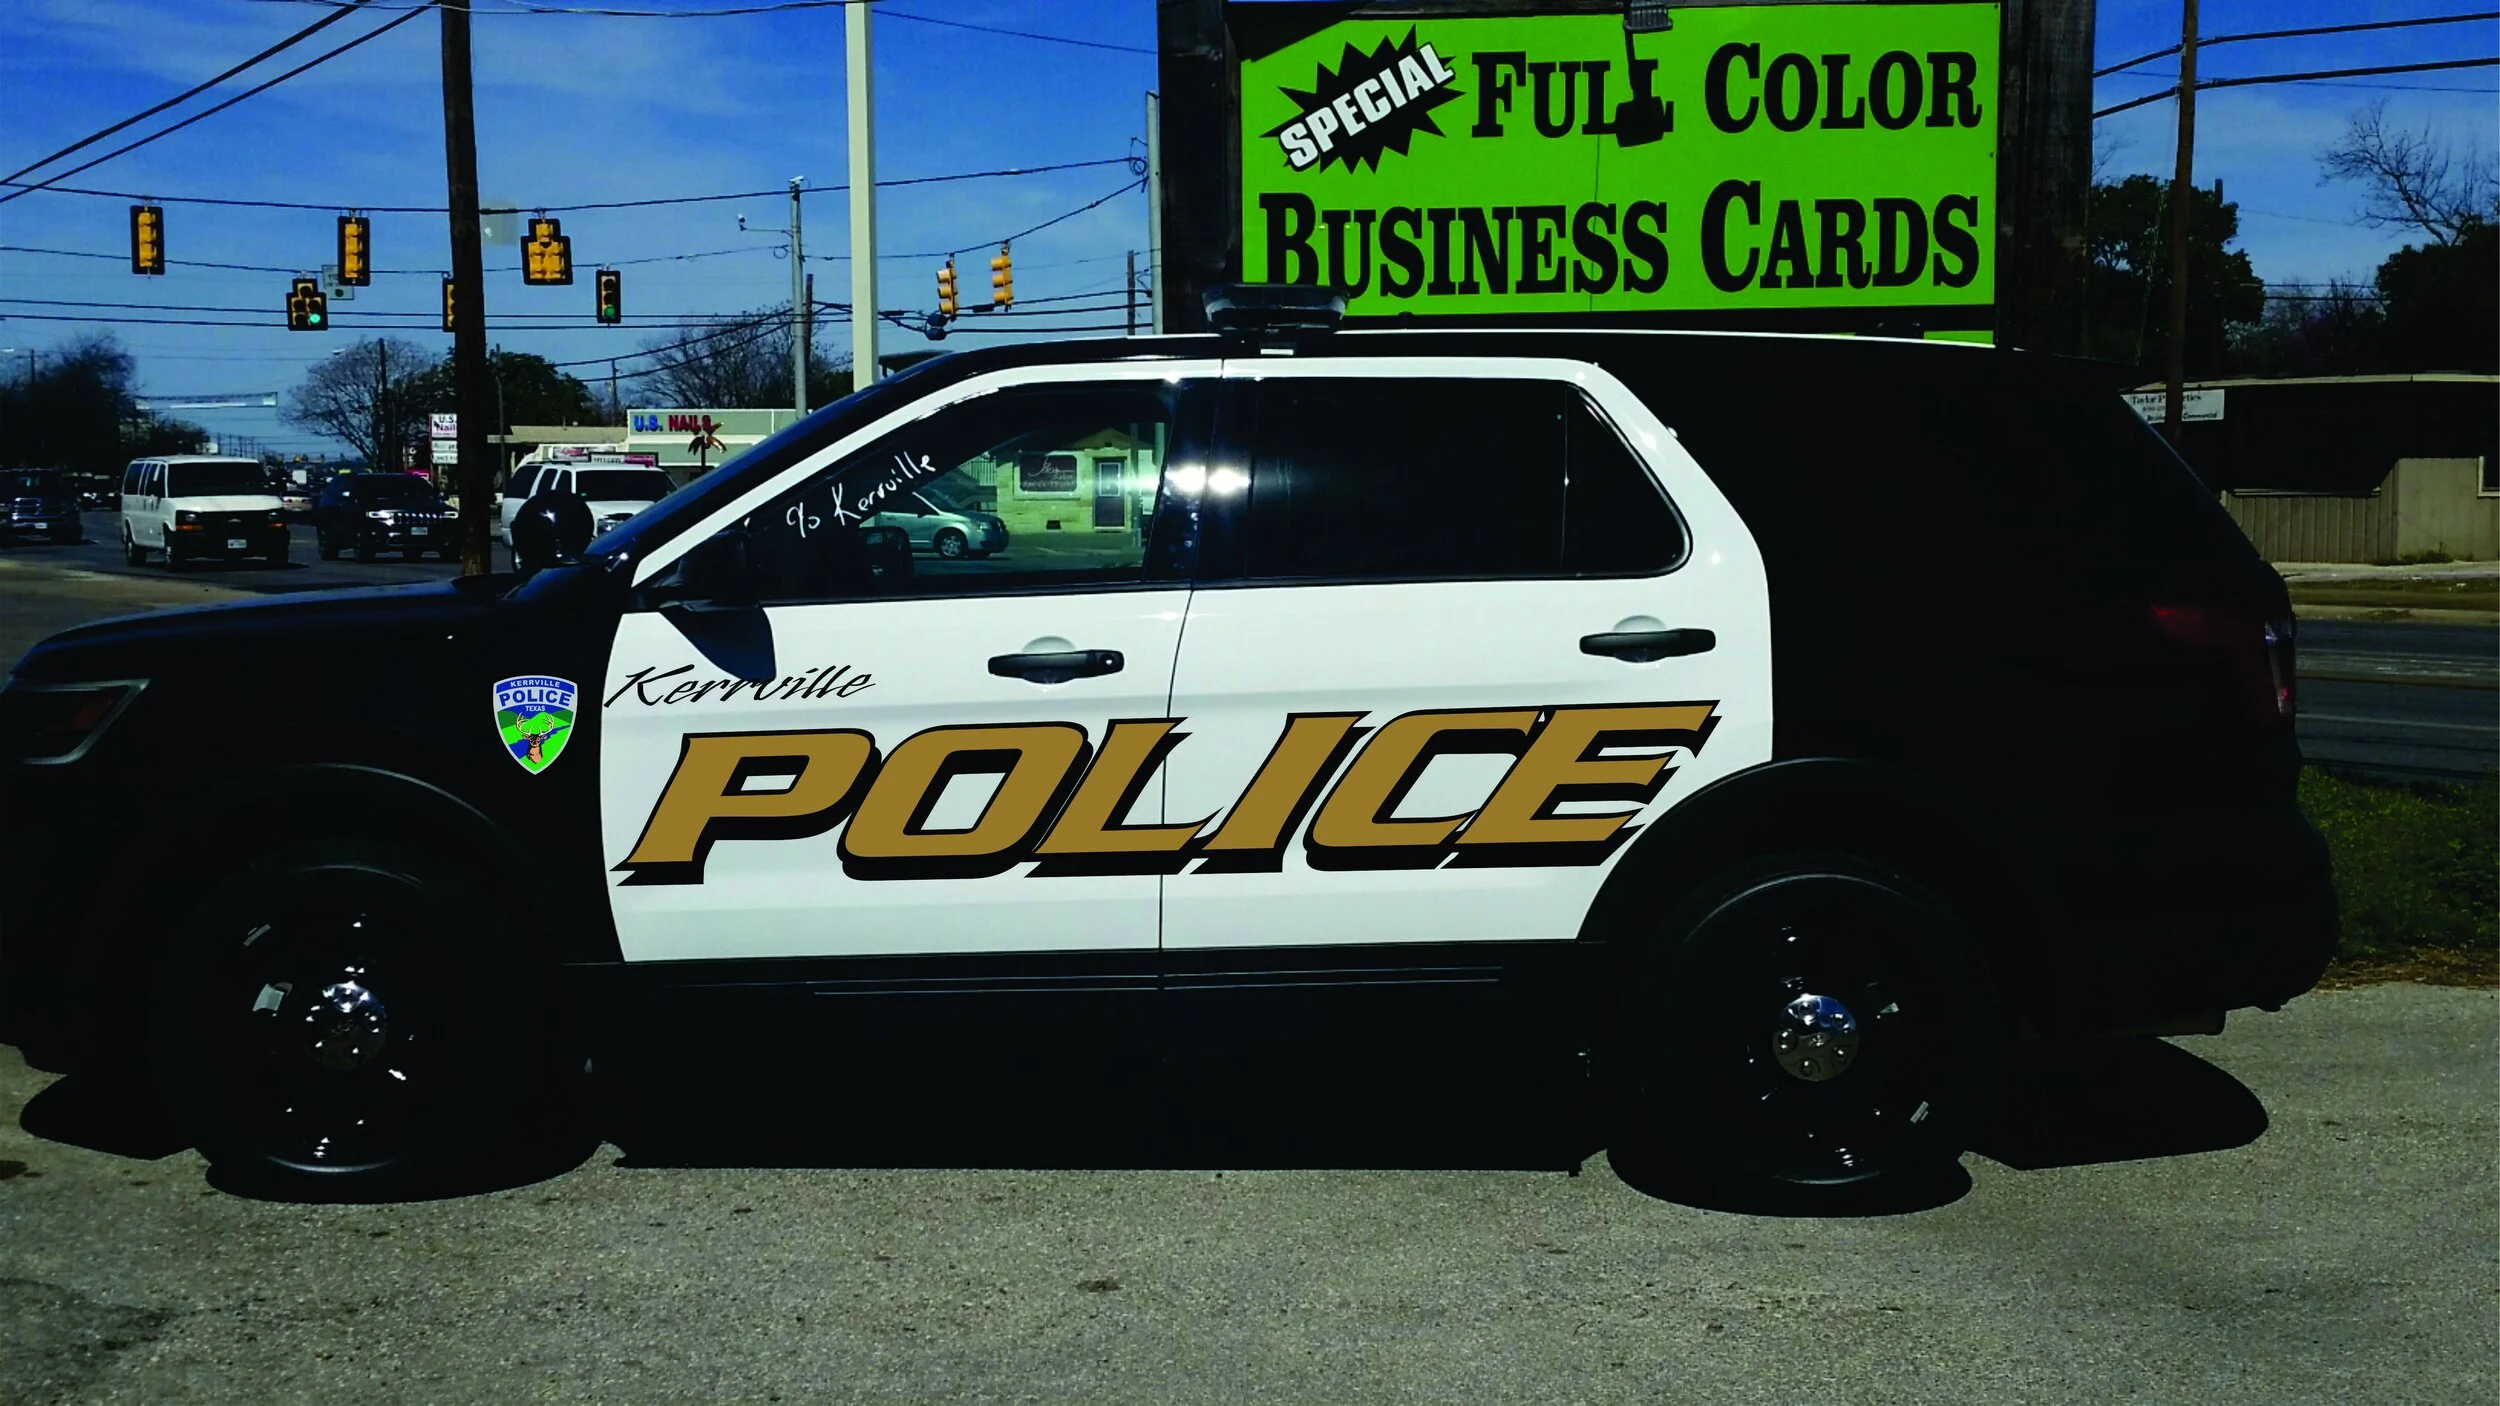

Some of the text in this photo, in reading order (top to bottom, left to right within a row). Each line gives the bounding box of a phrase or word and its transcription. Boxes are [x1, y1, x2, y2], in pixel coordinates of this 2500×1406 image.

[1279, 43, 1455, 170] SPECIAL
[1472, 42, 1983, 139] FULL COLOR
[1259, 179, 1980, 298] BUSINESS CARDS
[634, 414, 664, 432] U.S.
[831, 451, 937, 527] Kerrville
[498, 689, 572, 707] POLICE
[510, 679, 560, 688] KERRVILLE
[603, 664, 876, 708] Kerrville
[609, 700, 1722, 887] POLICE
